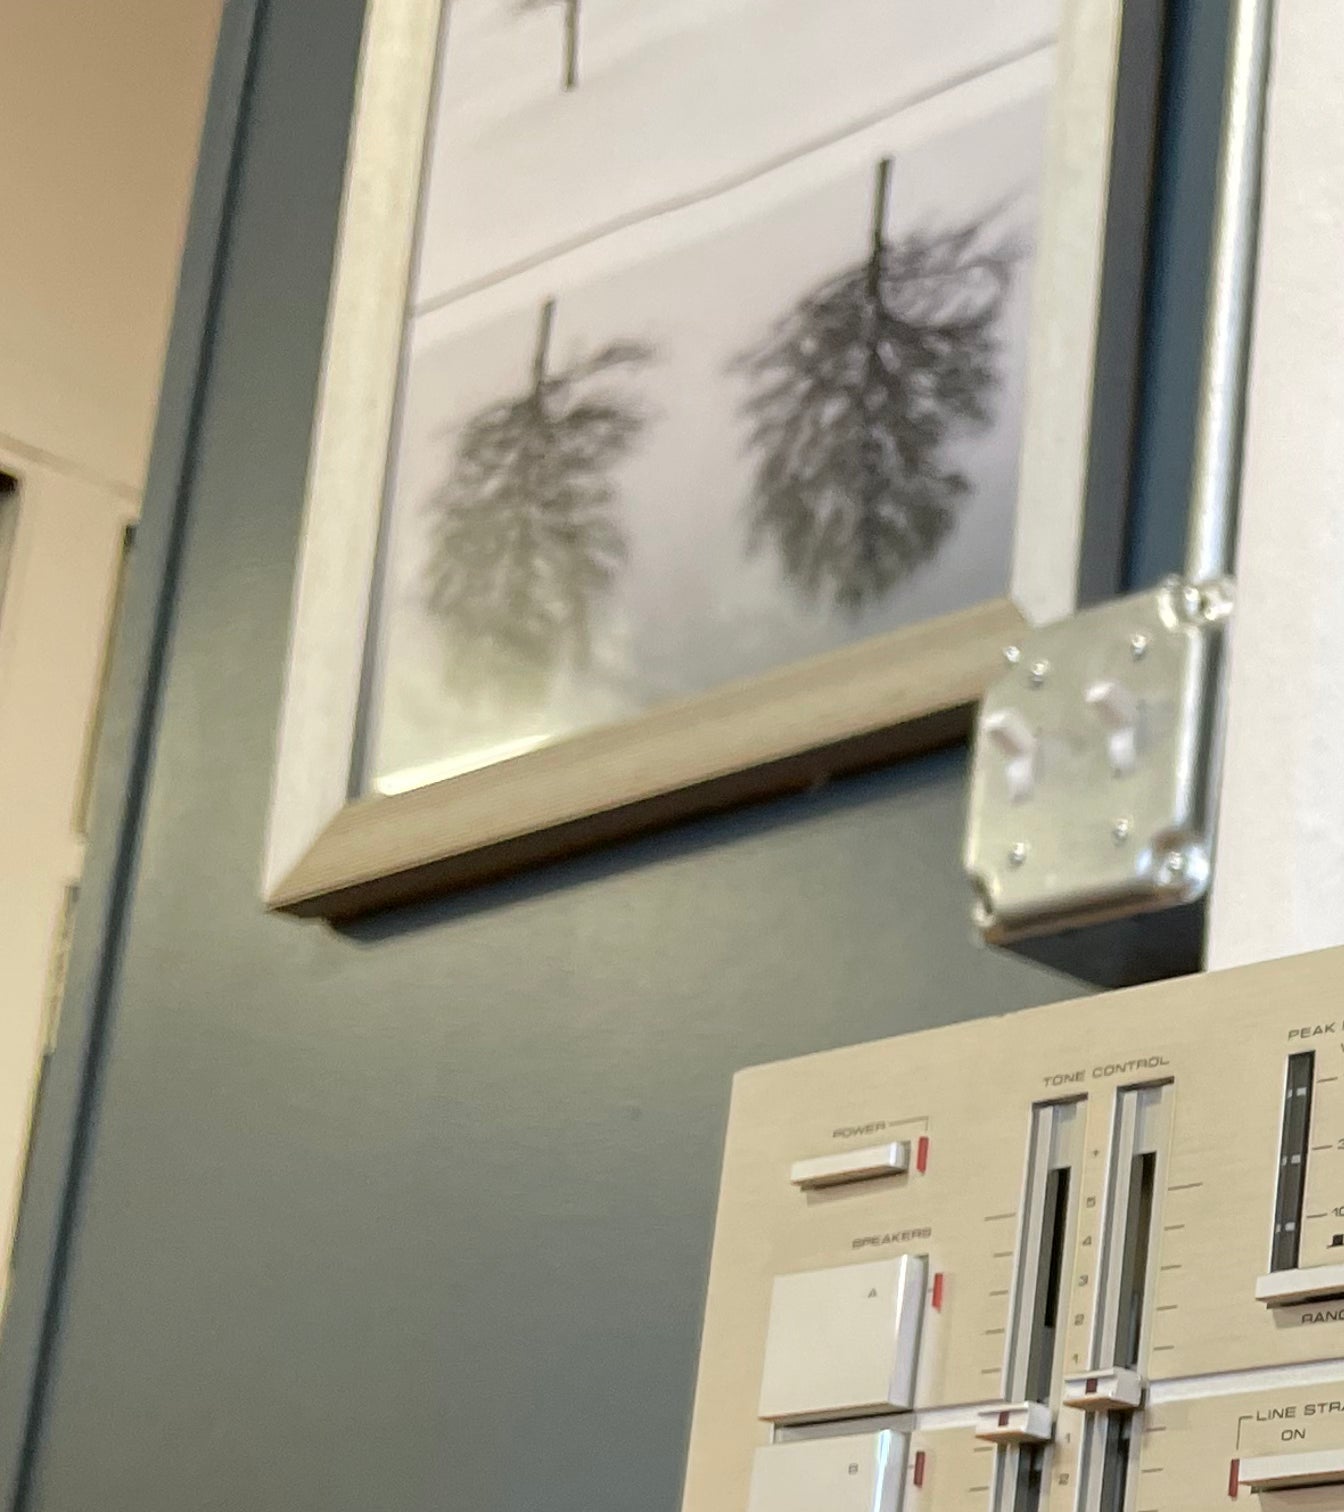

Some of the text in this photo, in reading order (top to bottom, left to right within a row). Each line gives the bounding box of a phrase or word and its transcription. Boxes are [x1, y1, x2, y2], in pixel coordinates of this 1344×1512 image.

[1288, 1022, 1336, 1040] PEAK
[1044, 1056, 1169, 1088] TONE CONTROL
[833, 1121, 886, 1138] POWER
[852, 1227, 932, 1249] SPEAKERS
[1256, 1405, 1297, 1422] LINE
[1281, 1428, 1307, 1442] ON
